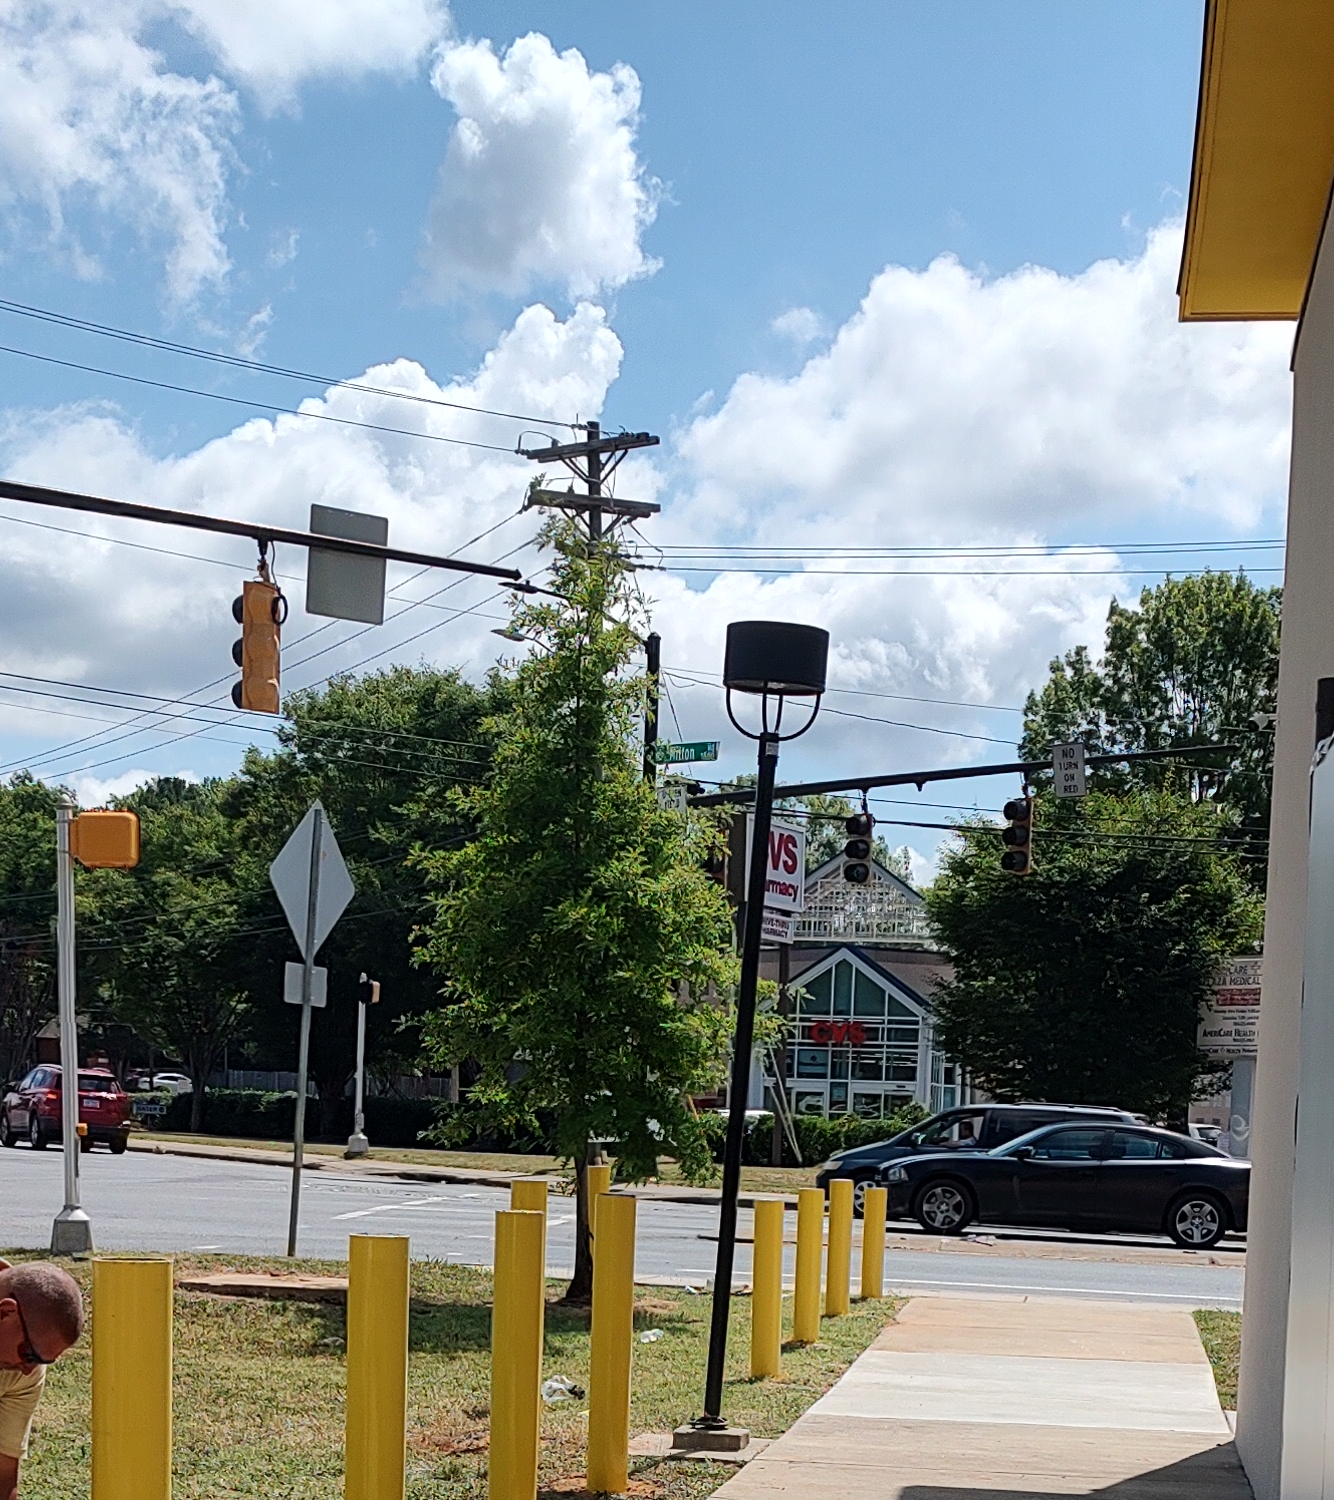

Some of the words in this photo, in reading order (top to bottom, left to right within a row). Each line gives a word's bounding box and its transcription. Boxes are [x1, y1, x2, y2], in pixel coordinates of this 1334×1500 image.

[1062, 748, 1075, 758] NO
[1058, 762, 1079, 770] TURN
[1064, 773, 1075, 782] ON
[1063, 785, 1079, 793] RED
[768, 831, 798, 875] VS
[766, 879, 799, 902] rmacy
[1229, 977, 1261, 986] MEDICAL
[810, 1021, 867, 1045] CVS
